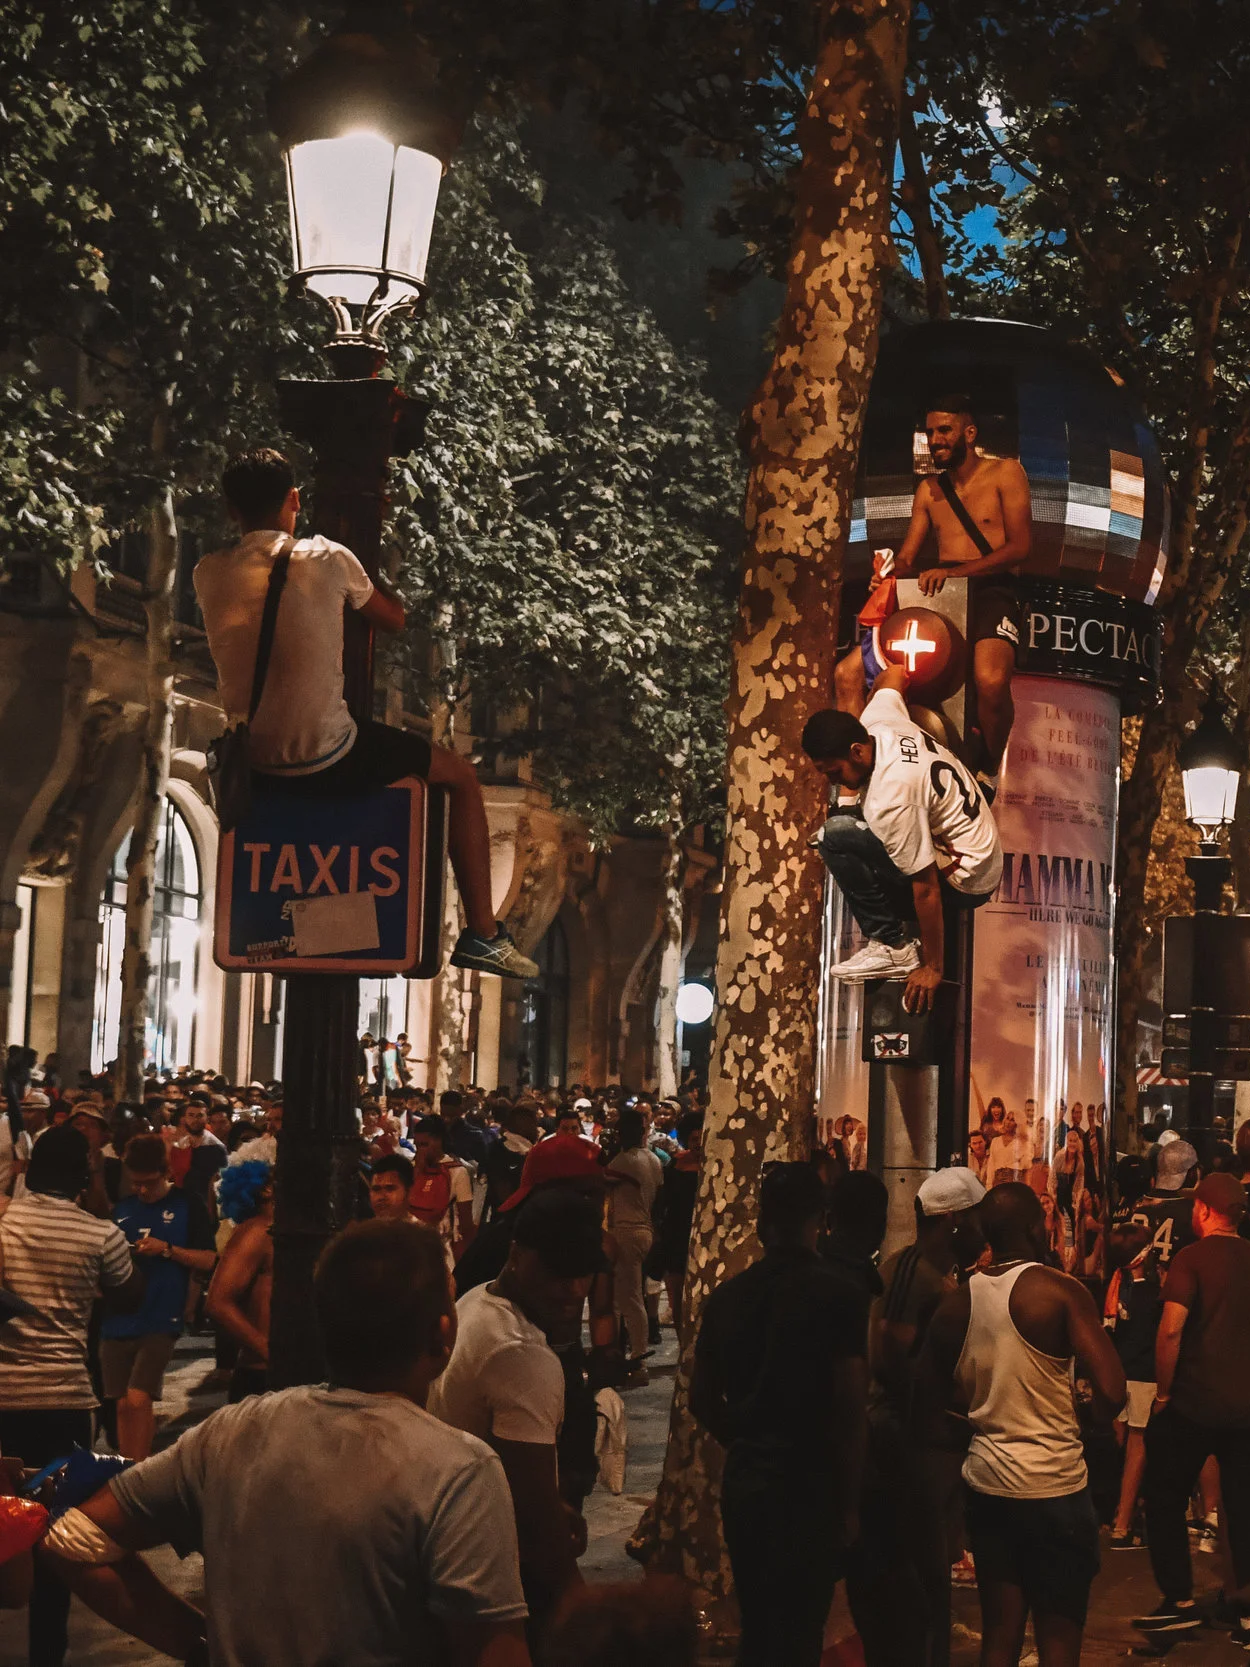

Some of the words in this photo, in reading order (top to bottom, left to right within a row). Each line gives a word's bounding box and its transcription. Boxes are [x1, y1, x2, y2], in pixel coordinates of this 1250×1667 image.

[898, 734, 919, 764] HEDI
[243, 843, 400, 897] TAXIS
[1029, 907, 1062, 922] HERE
